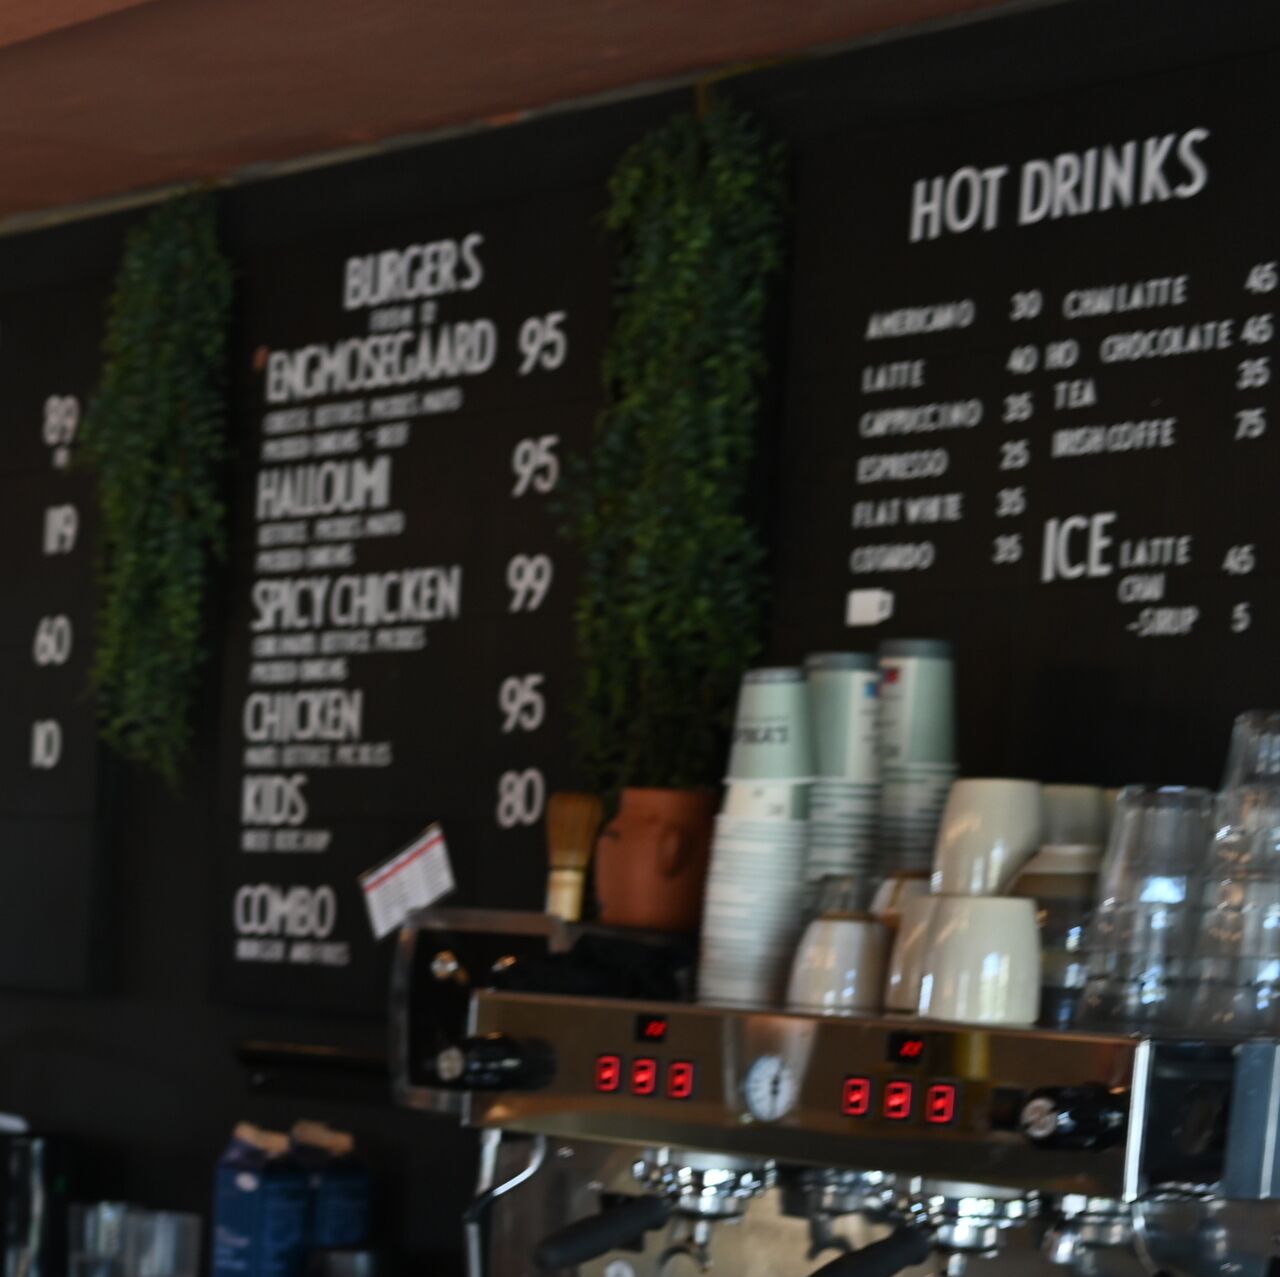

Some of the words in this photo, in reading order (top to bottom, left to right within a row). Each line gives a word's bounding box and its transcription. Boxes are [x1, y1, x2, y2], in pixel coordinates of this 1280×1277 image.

[911, 166, 1007, 241] HOT
[1020, 129, 1208, 224] DRINKS
[344, 233, 484, 311] BURGERS
[1117, 273, 1190, 312] LATTE
[520, 312, 565, 373] 95
[863, 361, 923, 392] LATTE
[1056, 381, 1095, 407] TEA
[514, 436, 558, 496] 95
[1038, 510, 1121, 583] ICE
[1120, 534, 1192, 569] LATTE
[508, 555, 551, 610] 99
[35, 616, 70, 664] 60
[500, 675, 543, 730] 95
[239, 772, 311, 828] KIDS
[498, 769, 543, 827] 80
[232, 882, 340, 939] COMBO
